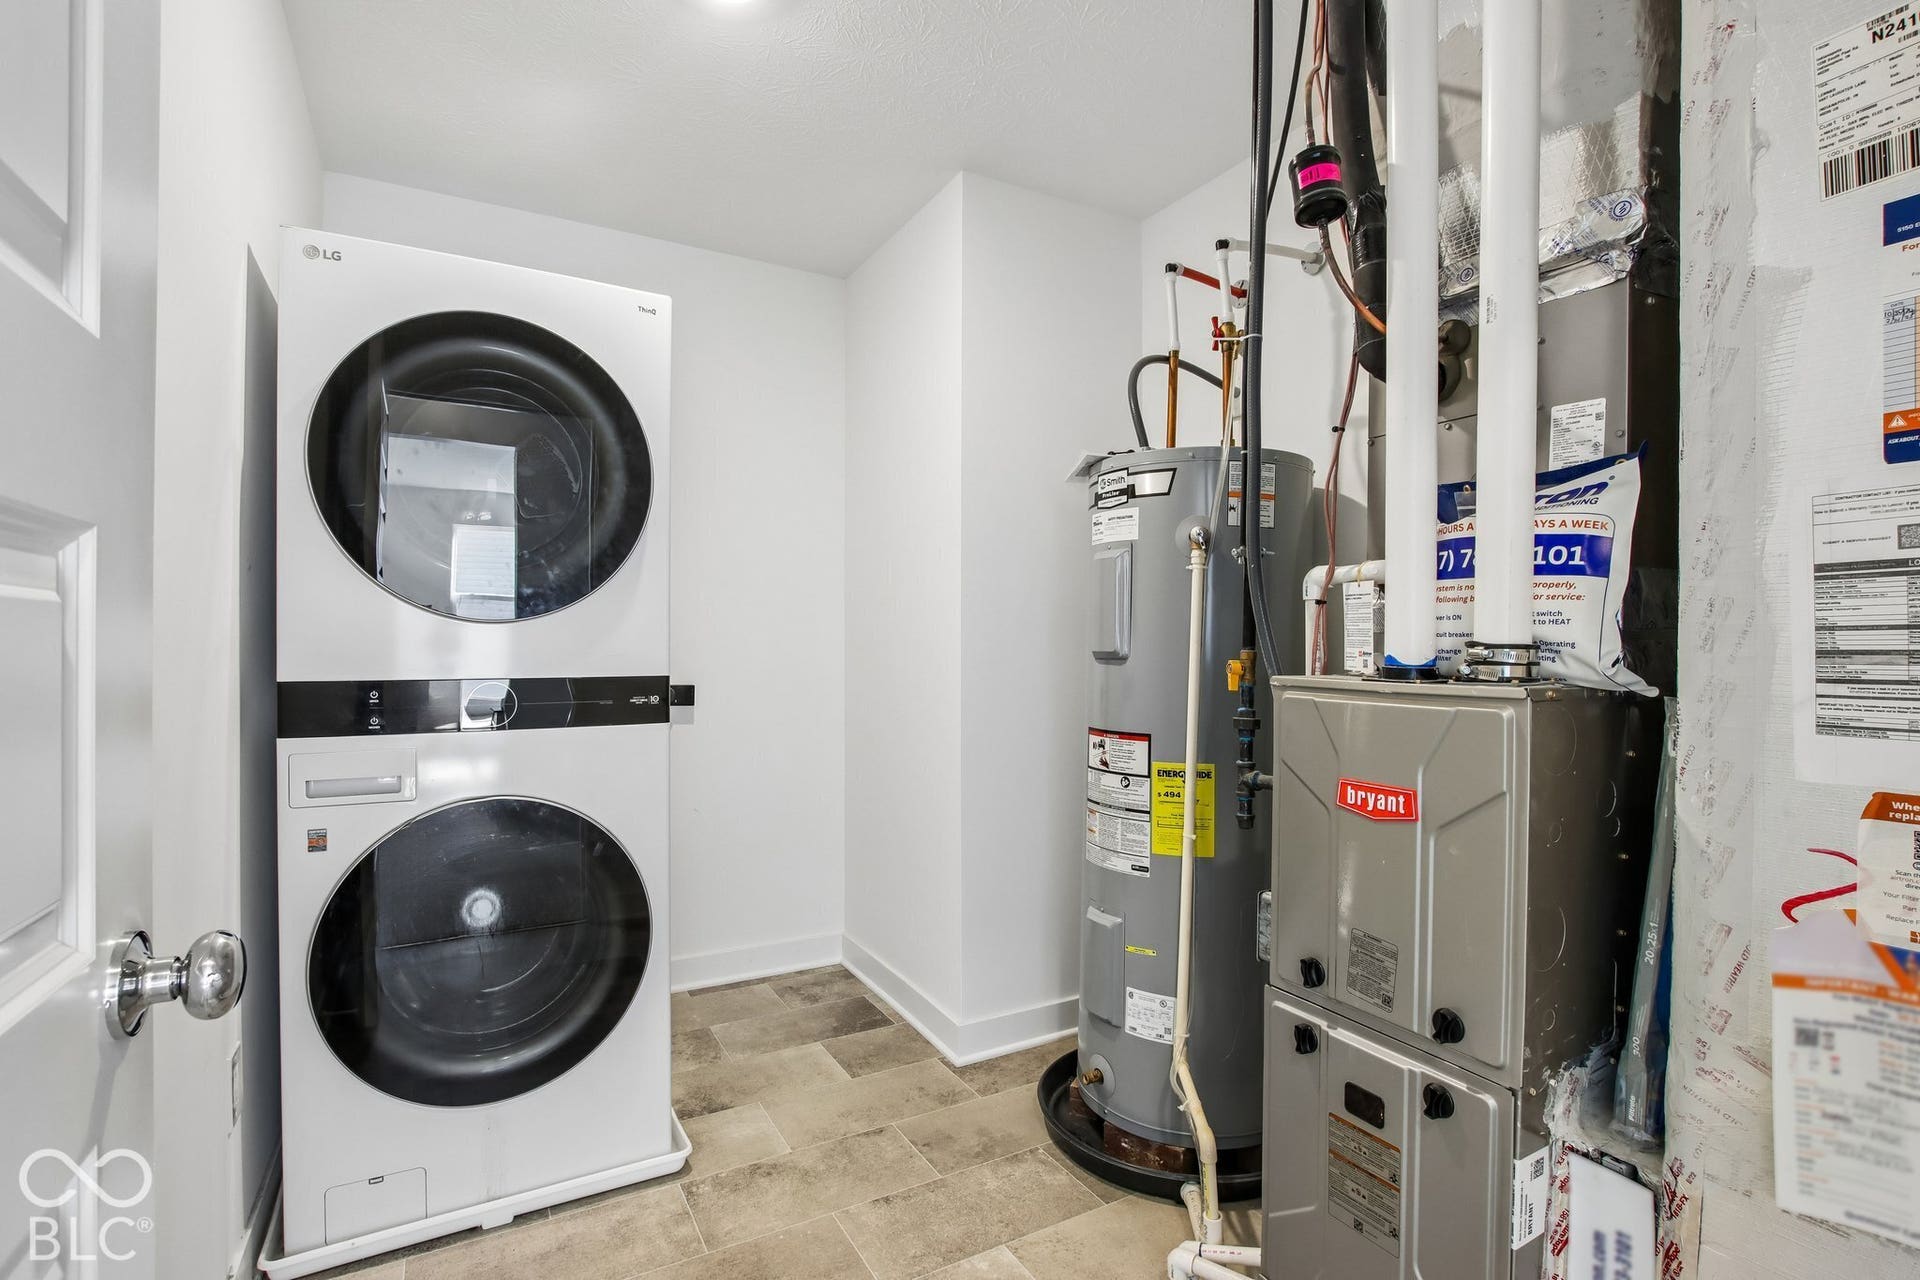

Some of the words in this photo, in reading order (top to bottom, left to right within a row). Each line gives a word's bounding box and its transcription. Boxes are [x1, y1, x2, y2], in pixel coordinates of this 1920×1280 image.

[1871, 13, 1920, 44] N241
[323, 248, 342, 261] LG
[1106, 476, 1126, 487] Smith
[1438, 523, 1464, 536] HOURS
[1467, 522, 1474, 531] A
[1534, 519, 1555, 528] AYS
[1559, 519, 1568, 528] A
[1571, 519, 1608, 531] WEEK
[1438, 549, 1455, 572] 7)
[1534, 545, 1585, 565] 101
[1436, 585, 1455, 593] stem
[1545, 592, 1586, 600] service:
[1539, 640, 1576, 649] Operating
[1163, 790, 1182, 798] 494
[1347, 786, 1405, 814] bryant
[1892, 801, 1920, 812] Whe
[1889, 811, 1920, 821] repla
[1896, 869, 1911, 877] Scan
